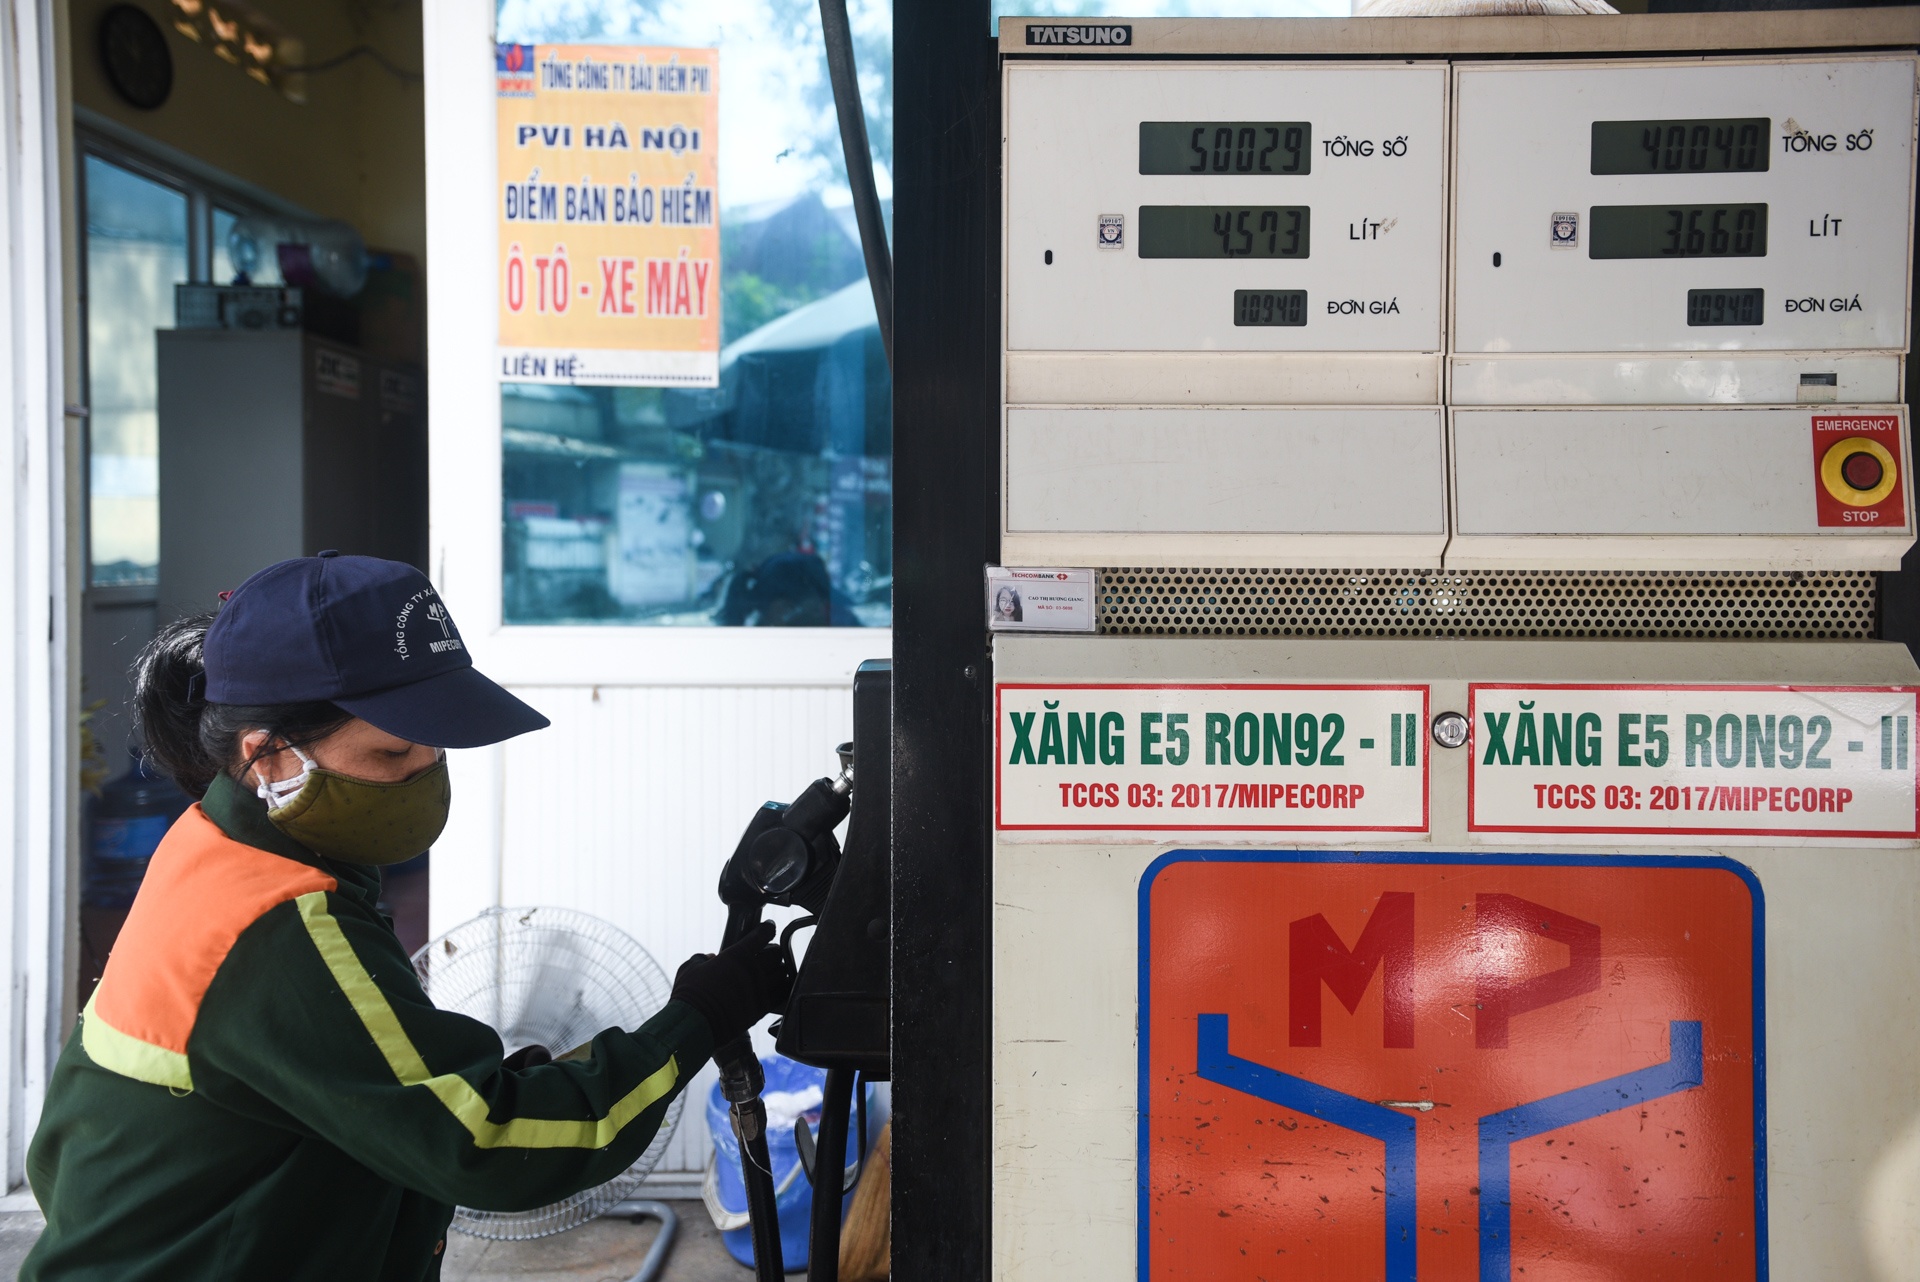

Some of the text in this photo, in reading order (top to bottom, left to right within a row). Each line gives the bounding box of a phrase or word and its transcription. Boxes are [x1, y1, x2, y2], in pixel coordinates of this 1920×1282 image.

[1031, 27, 1127, 44] TATSUNO
[500, 80, 532, 91] PVI
[577, 57, 608, 90] CÔNG
[613, 65, 625, 91] TY
[519, 121, 700, 157] PVI HÀ NỘI
[1190, 127, 1303, 172] 50029
[1322, 135, 1408, 157] TỔNG SỐ
[1643, 125, 1759, 170] 40040
[1782, 129, 1874, 152] TỔNG SỐ
[506, 167, 711, 224] ĐIỂM BÁN BẢO HIỂM
[1350, 218, 1380, 240] LÍT
[1810, 214, 1842, 236] LÍT
[507, 246, 525, 312] Ô
[535, 246, 569, 313] TÔ
[601, 258, 635, 314] XE
[647, 249, 709, 317] MÁY
[1242, 295, 1301, 322] 10940
[1327, 298, 1399, 315] ĐƠN GIÁ
[1692, 295, 1754, 322] 10940
[1785, 294, 1862, 313] ĐƠN GIÁ
[502, 354, 546, 377] LIÊN
[1817, 420, 1894, 431] EMERGENCY
[1843, 511, 1879, 522] STOP
[411, 592, 423, 603] TY
[396, 602, 414, 629] CÔNG
[394, 631, 410, 660] TỔNG
[1008, 700, 1417, 767] XĂNG E5 RON92 - II
[1483, 700, 1908, 770] XĂNG E5 RON92 - II
[1059, 783, 1365, 809] TCCS 03: 2017/MIPECORP
[1534, 784, 1853, 812] TCCS 03: 2017/MIPECORP
